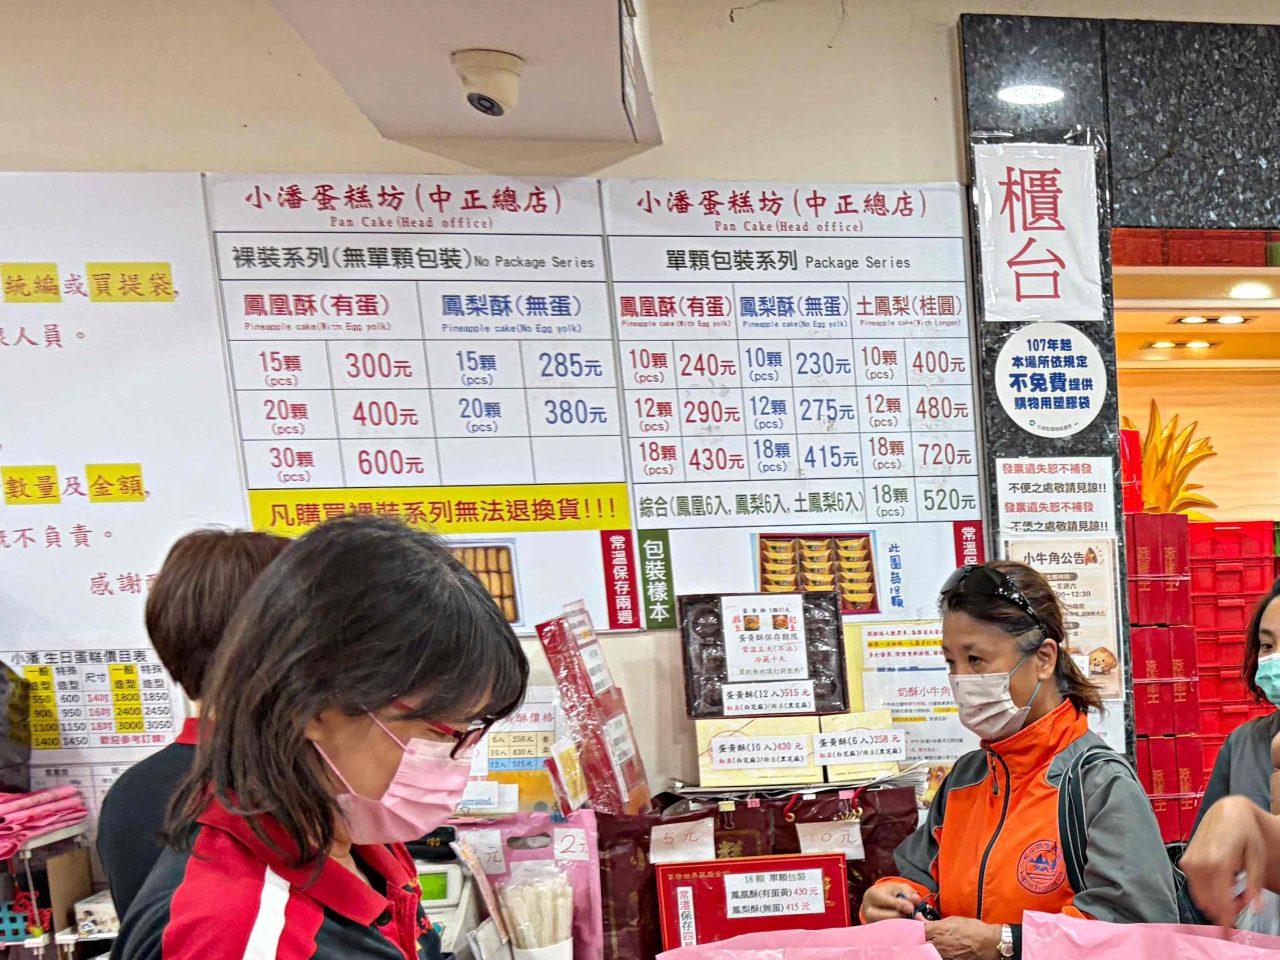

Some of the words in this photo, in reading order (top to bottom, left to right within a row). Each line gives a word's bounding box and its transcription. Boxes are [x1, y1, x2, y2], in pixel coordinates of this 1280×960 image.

[244, 182, 562, 215] 小潘蛋糕坊(中正總店)
[636, 188, 927, 219] 小潘蛋糕坊(中正總店)
[330, 216, 354, 227] Pan
[441, 217, 494, 229] office)
[714, 221, 737, 231] Pan
[817, 221, 864, 232] office)
[998, 166, 1066, 303] 櫃台
[231, 246, 472, 269] 裸裝系列(無單顆包裝)
[495, 255, 547, 270] Package
[552, 256, 595, 268] Series
[666, 249, 798, 271] 單顆包裝系列
[806, 256, 859, 270] Package
[866, 256, 911, 269] Series
[243, 293, 391, 317] 鳳凰酥(有蛋)
[441, 293, 583, 318] 鳳梨酥(無蛋)
[620, 295, 733, 318] 鳳凰酥(有蛋)
[740, 296, 849, 318] 鳳梨酥(無蛋)
[856, 295, 962, 317] 土鳳梨(桂圓)
[1026, 338, 1072, 352] 107年起
[259, 351, 303, 372] 15顆
[345, 352, 414, 378] 300元
[456, 351, 498, 372] 15顆
[538, 352, 604, 378] 285元
[629, 349, 668, 370] 10顆
[679, 354, 737, 377] 240元
[745, 347, 783, 368] 10顆
[796, 352, 852, 375] 230元
[861, 346, 898, 367] 10顆
[912, 351, 966, 374] 400元
[1011, 355, 1089, 368] 本場所依規定
[264, 375, 299, 387] (pcs)
[460, 374, 495, 386] (pcs)
[634, 371, 665, 384] (pcs)
[749, 369, 779, 382] (pcs)
[865, 368, 895, 381] (pcs)
[1008, 372, 1094, 393] 不免費提供
[263, 399, 310, 421] 20顆
[458, 398, 503, 419] 20顆
[543, 399, 608, 425] 380元
[635, 397, 673, 419] 12顆
[683, 400, 741, 424] 290元
[750, 395, 788, 417] 12顆
[799, 399, 855, 421] 275元
[864, 394, 902, 414] 12顆
[916, 396, 969, 419] 480元
[1014, 395, 1091, 410] 購物用塑膠袋
[352, 401, 419, 427] 400元
[754, 418, 784, 430] (pcs)
[869, 416, 899, 428] (pcs)
[271, 423, 306, 436] (pcs)
[466, 420, 499, 433] (pcs)
[639, 420, 670, 433] (pcs)
[639, 441, 678, 462] 18顆
[753, 439, 791, 460] 18顆
[868, 436, 905, 457] 18顆
[918, 442, 972, 466] 720元
[269, 447, 316, 468] 30顆
[358, 449, 425, 475] 600元
[688, 447, 745, 471] 430元
[757, 461, 787, 474] (pcs)
[804, 446, 859, 469] 415元
[872, 458, 902, 471] (pcs)
[276, 470, 312, 483] (pcs)
[643, 464, 675, 476] (pcs)
[1002, 463, 1093, 475] 發票遺失恕不補發
[872, 484, 909, 505] 18顆
[1008, 481, 1108, 494] 不便之處敬請見諒!!
[923, 488, 977, 511] 520元
[1004, 501, 1095, 513] 發票遺失恕不補發
[876, 507, 906, 518] (pcs)
[1010, 520, 1109, 533] 不便之處敬請見諒!!
[1023, 552, 1085, 566] 小牛角公告
[609, 534, 633, 625] 常溫保存兩週
[643, 538, 671, 620] 包裝樣本
[793, 886, 808, 895] 430
[809, 886, 819, 895] 元
[785, 903, 800, 911] 415
[802, 901, 811, 911] 元
